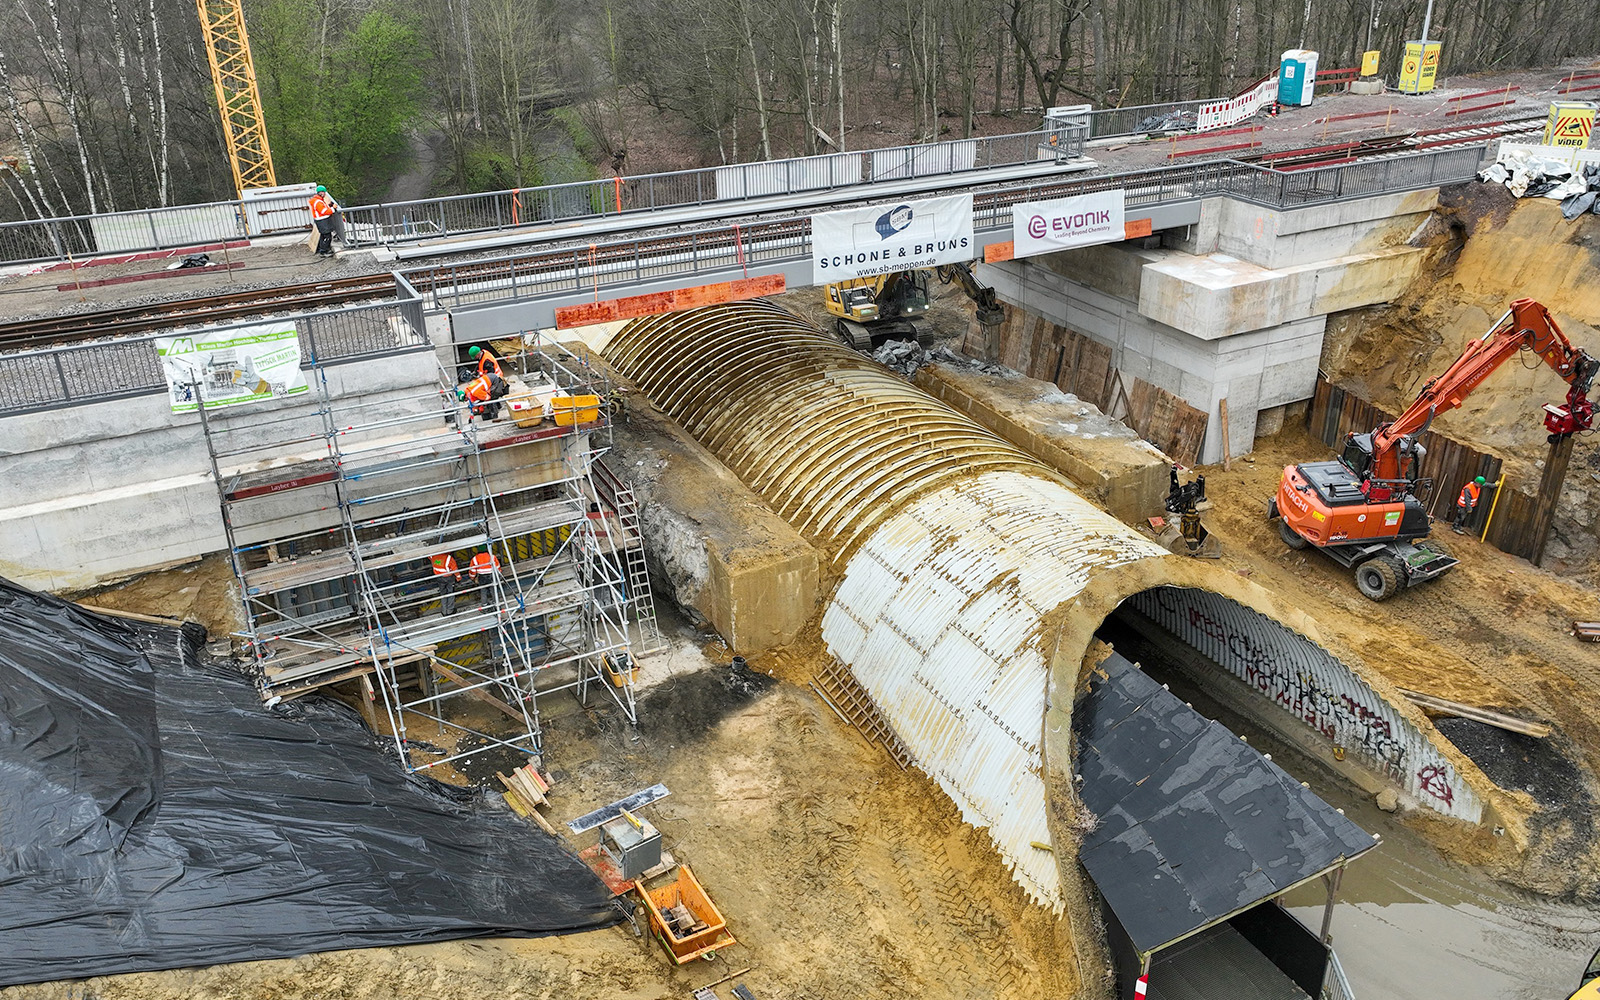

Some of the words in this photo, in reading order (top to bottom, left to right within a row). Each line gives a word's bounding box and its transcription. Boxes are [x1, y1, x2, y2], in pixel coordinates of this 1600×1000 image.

[1052, 210, 1110, 231] EVONIK
[1054, 231, 1071, 239] Leading
[1071, 228, 1088, 237] Beyond
[1088, 225, 1110, 234] Chemistry
[820, 249, 891, 269] SCHONE
[898, 247, 907, 257] &
[914, 237, 968, 255] BRUNS
[856, 258, 937, 277] www.sb-meppen.de
[217, 340, 233, 348] Martin
[277, 331, 294, 340] GmbH
[276, 349, 297, 362] MARTIN
[1465, 362, 1494, 388] HITACHI
[270, 482, 290, 492] Layher
[1283, 482, 1309, 513] HITACHI
